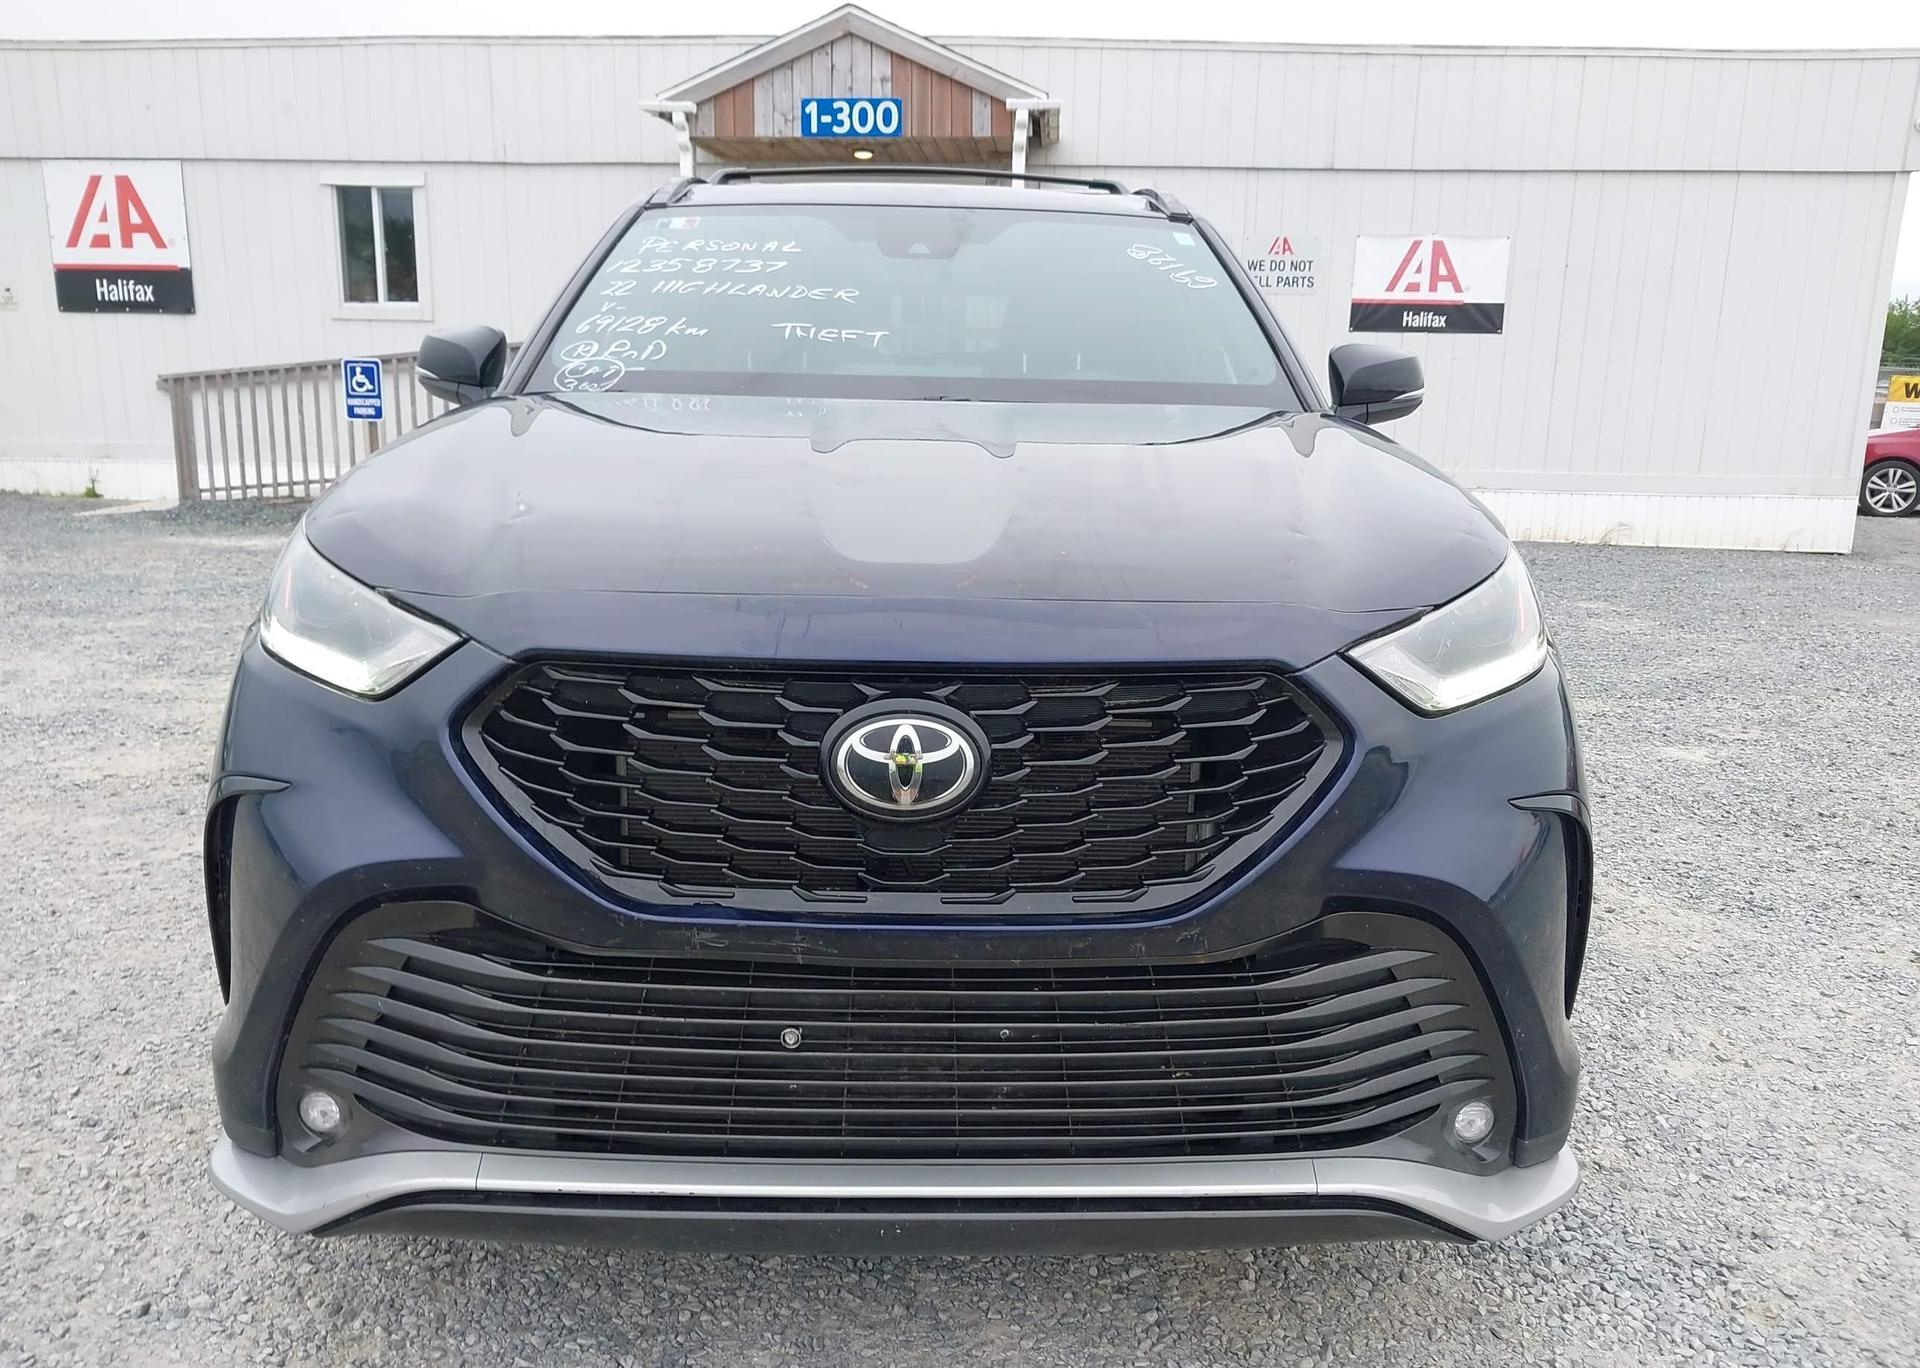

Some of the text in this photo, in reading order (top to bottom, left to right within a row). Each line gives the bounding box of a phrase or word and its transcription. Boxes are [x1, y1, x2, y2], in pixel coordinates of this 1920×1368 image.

[804, 101, 899, 134] 1-300
[638, 236, 803, 255] PERSONAL
[605, 258, 788, 273] 12358737
[1247, 260, 1314, 272] WE DO NOT
[95, 278, 155, 302] Halifax
[600, 279, 860, 303] 22 HIGHLANDER
[1254, 276, 1314, 288] LL PARTS
[576, 315, 667, 335] 69128
[1402, 311, 1447, 328] Halifax
[771, 322, 891, 348] THEFT
